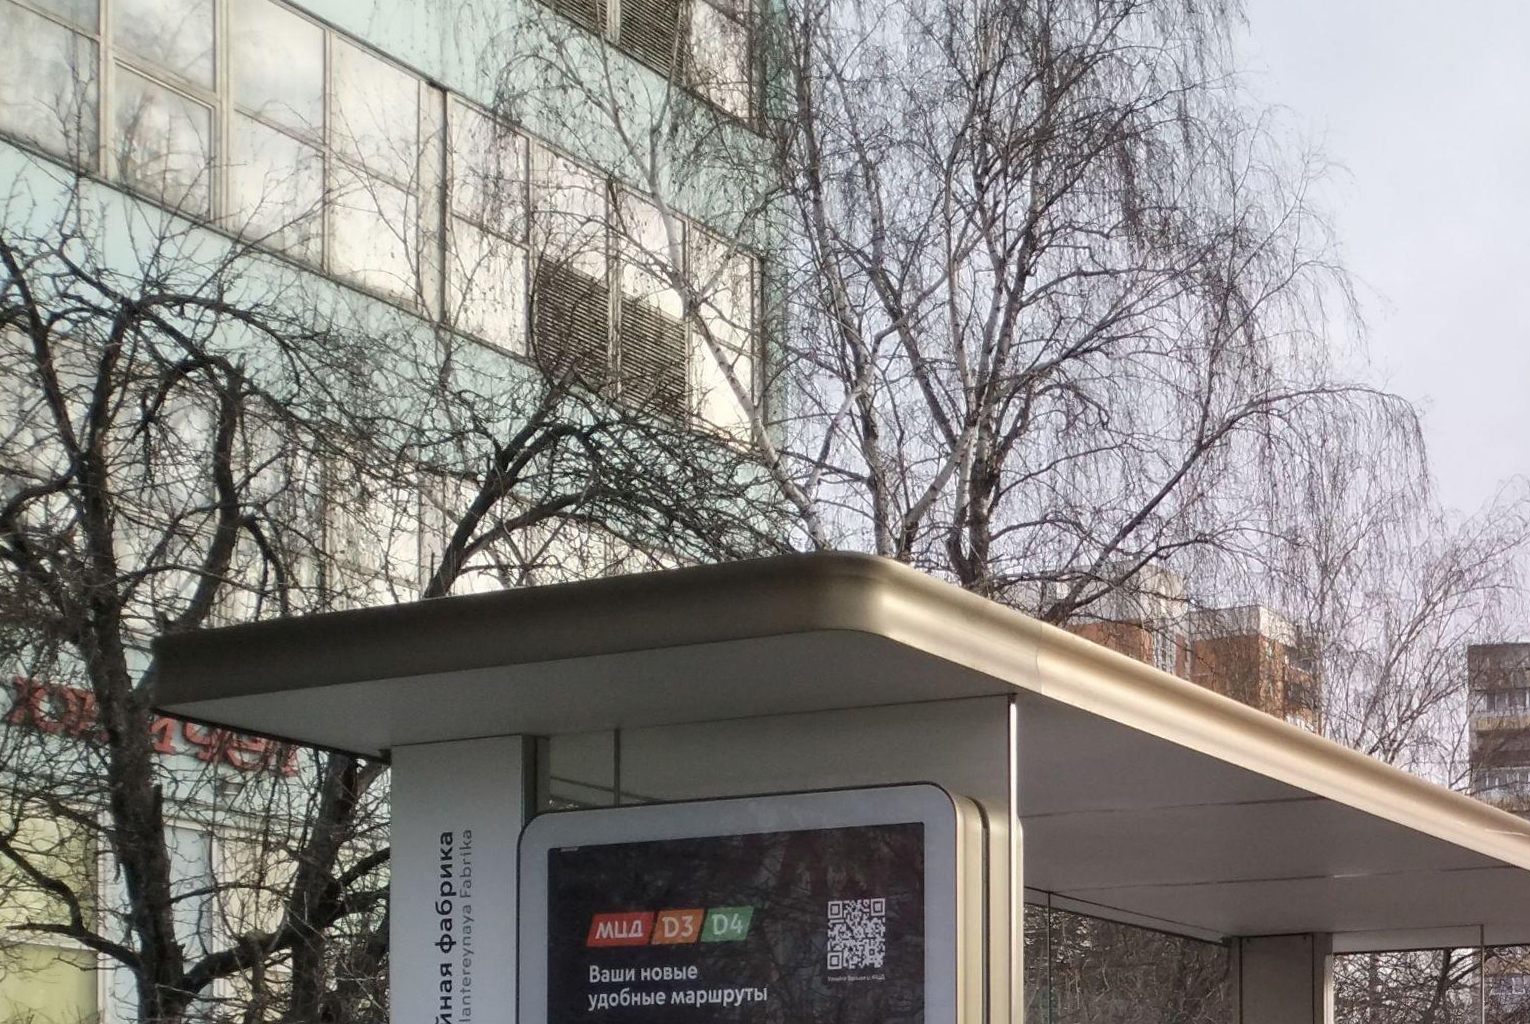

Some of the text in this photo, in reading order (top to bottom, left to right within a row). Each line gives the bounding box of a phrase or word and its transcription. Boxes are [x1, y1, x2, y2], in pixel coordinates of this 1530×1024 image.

[459, 829, 473, 899] Fabrika
[434, 831, 457, 953] фабрика
[595, 913, 744, 940] МЦД D3 D4
[589, 964, 698, 983] Ваши новые
[587, 986, 768, 1012] удобные маршруты
